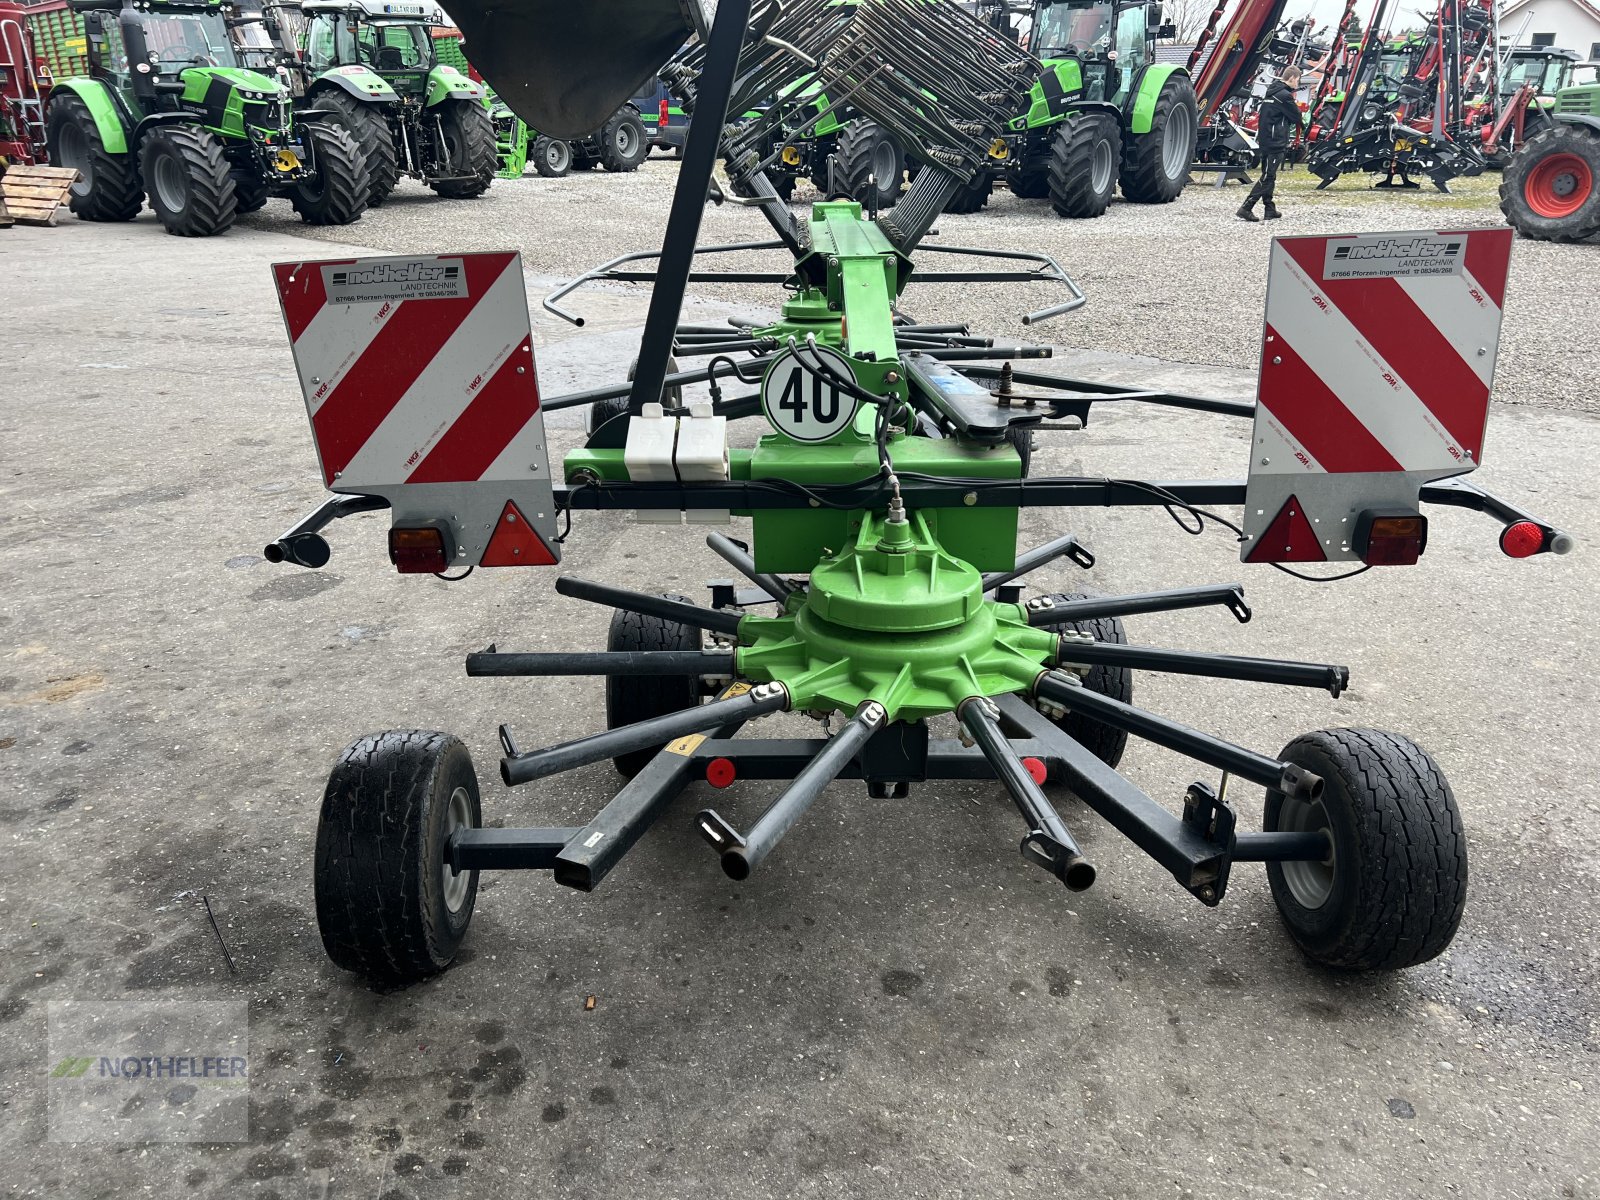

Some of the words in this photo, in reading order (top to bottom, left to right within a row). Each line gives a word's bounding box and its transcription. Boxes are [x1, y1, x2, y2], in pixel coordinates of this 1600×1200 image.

[1348, 238, 1446, 259] nothelfer
[1398, 258, 1455, 267] LANDTECHNIK
[348, 263, 443, 285] nothelfer
[400, 281, 457, 291] LANDTECHNIK
[1312, 294, 1328, 311] WGF
[1469, 287, 1484, 303] WGF
[377, 301, 391, 318] WGF
[469, 374, 483, 391] WGF
[1382, 372, 1398, 388] WGF
[315, 382, 328, 398] WGF
[779, 368, 839, 423] 40
[407, 450, 421, 467] WGF
[1294, 451, 1310, 467] WGF
[1447, 445, 1461, 460] WGF
